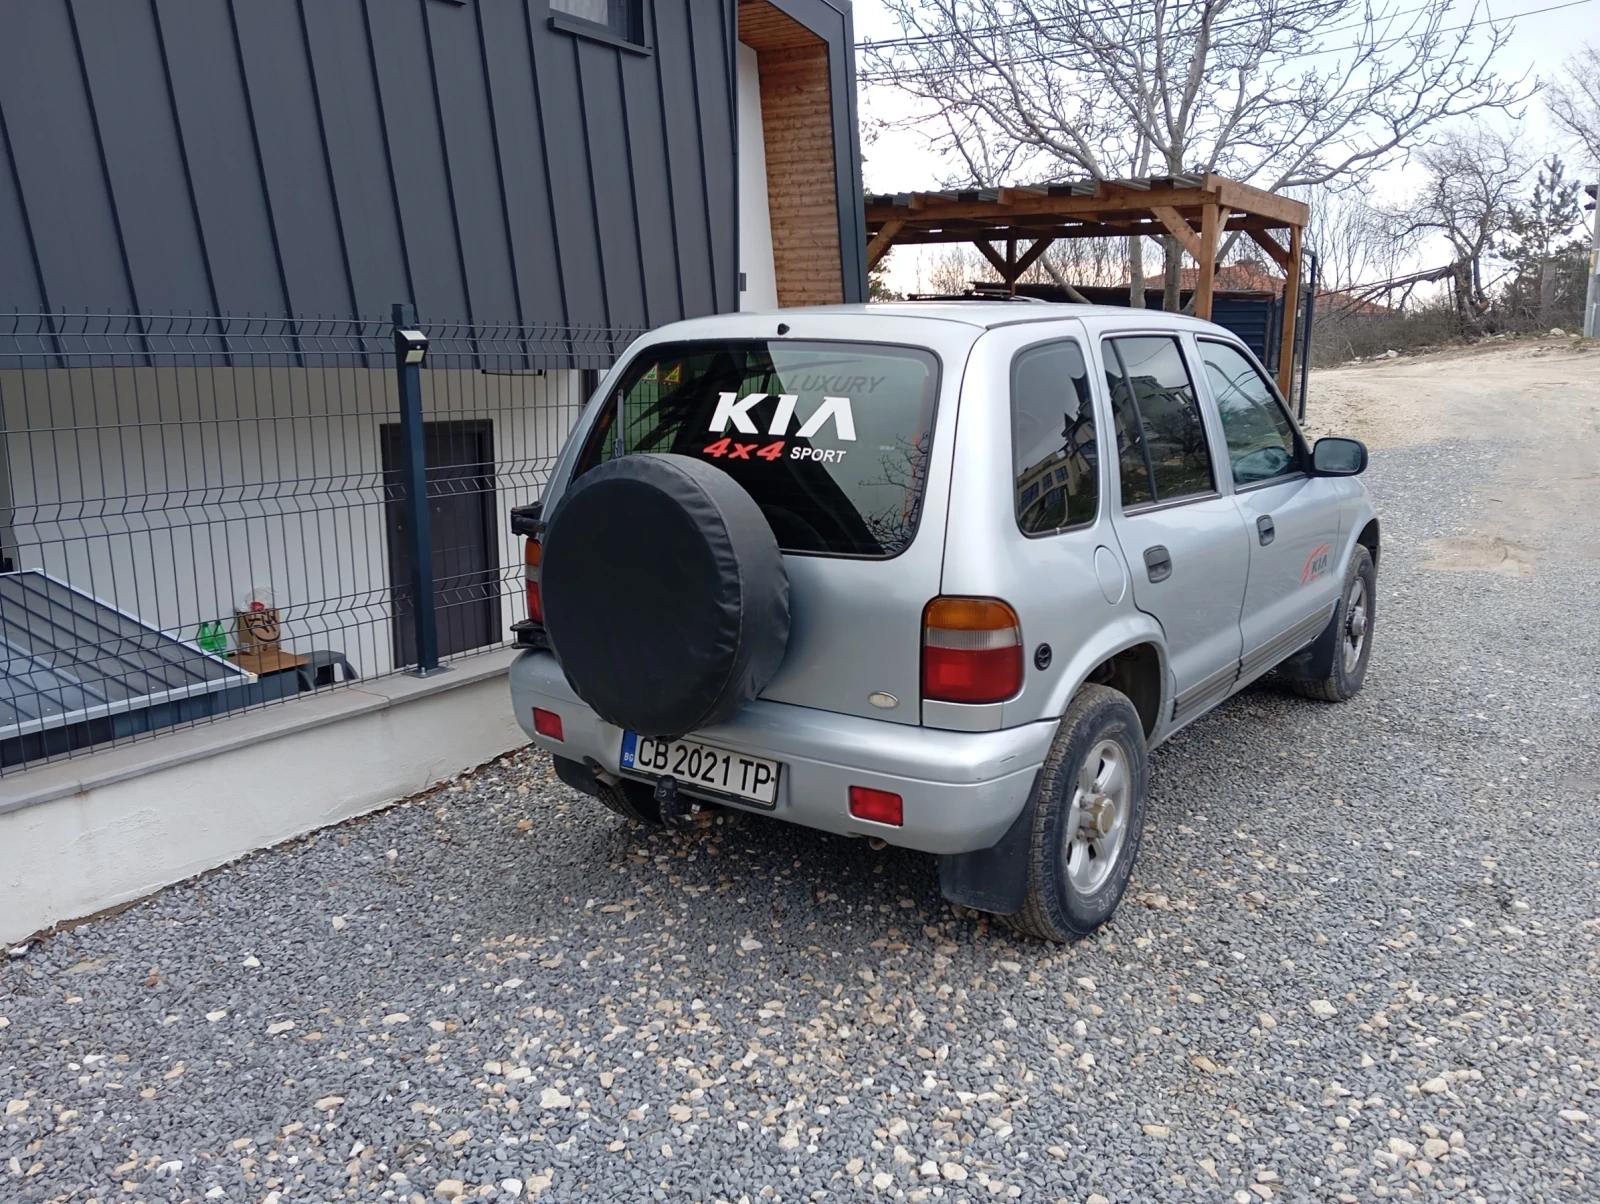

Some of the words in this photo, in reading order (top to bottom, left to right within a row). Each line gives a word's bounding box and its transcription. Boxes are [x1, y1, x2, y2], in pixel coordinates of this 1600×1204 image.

[786, 374, 886, 394] LUXURY
[708, 391, 857, 441] KIA
[703, 437, 786, 461] 4x4
[790, 447, 846, 463] SPORT
[1311, 554, 1328, 575] KIA
[624, 752, 634, 763] BG
[672, 744, 731, 786] 2021
